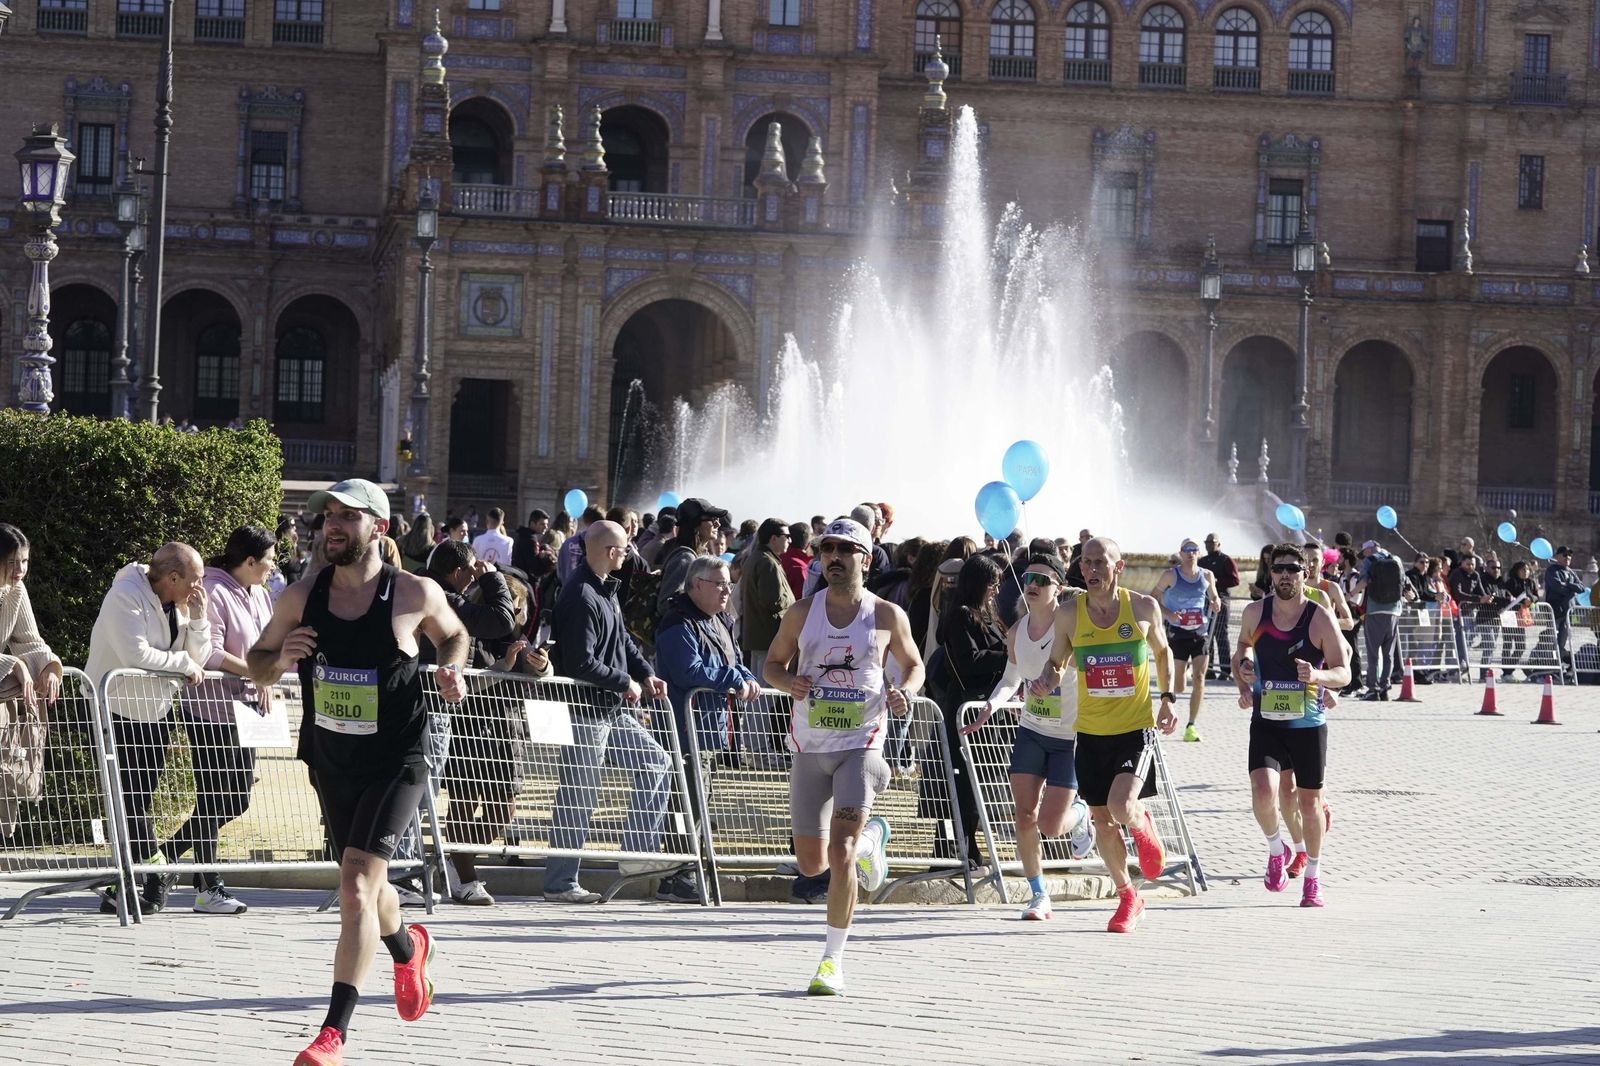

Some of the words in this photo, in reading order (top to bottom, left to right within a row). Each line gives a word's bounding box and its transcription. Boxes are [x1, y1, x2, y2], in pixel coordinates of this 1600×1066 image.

[1099, 655, 1127, 663] ZURICH
[328, 671, 368, 682] ZURICH
[1102, 678, 1118, 687] LEE
[330, 690, 351, 700] 2110
[827, 690, 860, 699] ZURICH
[324, 701, 362, 718] PABLO
[828, 706, 845, 714] 1644
[1273, 703, 1290, 711] ASA
[820, 716, 851, 728] KEVIN
